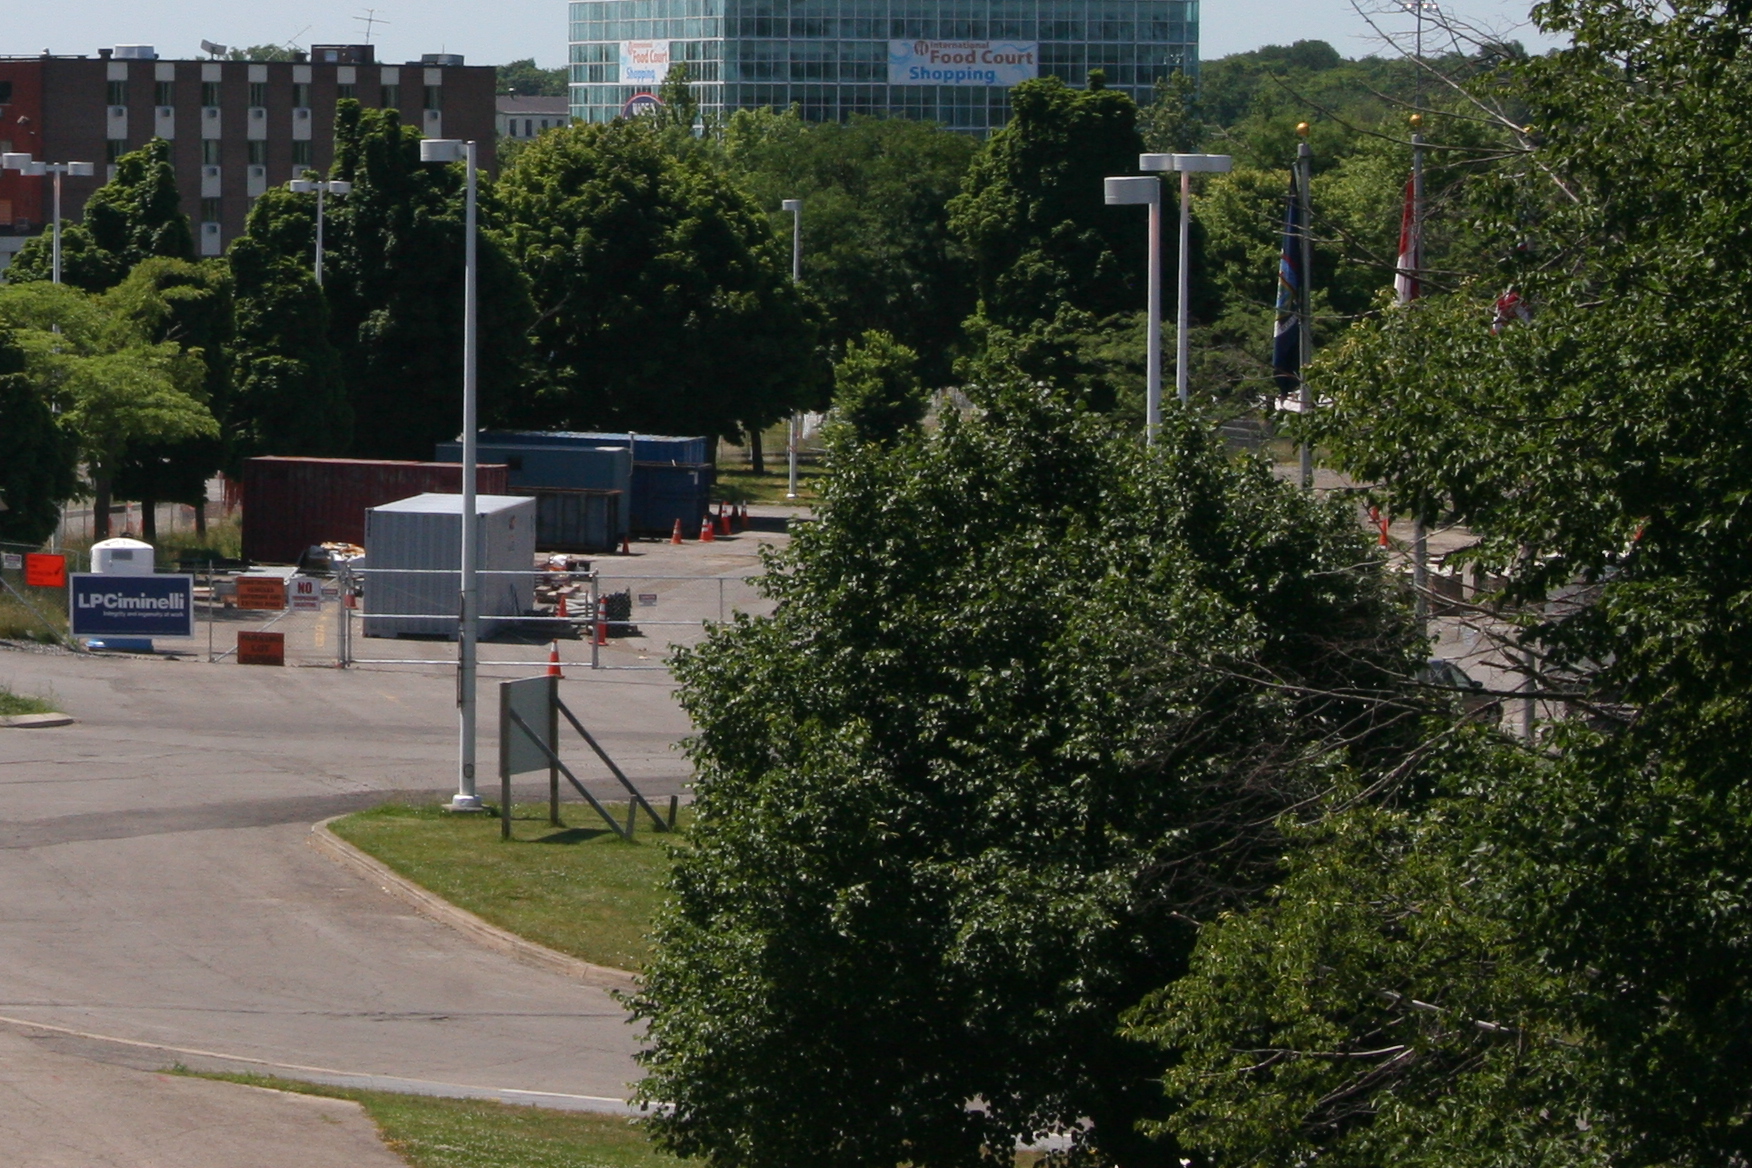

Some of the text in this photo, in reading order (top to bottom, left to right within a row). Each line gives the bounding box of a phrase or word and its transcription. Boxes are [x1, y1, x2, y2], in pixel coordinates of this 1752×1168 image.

[930, 41, 990, 49] International
[633, 49, 668, 64] Food Court
[930, 50, 1034, 65] Food Court
[626, 66, 656, 83] Shopping
[909, 66, 995, 84] Shopping
[298, 581, 312, 594] NO
[78, 592, 185, 609] LPCiminelli
[103, 610, 126, 618] Integrity
